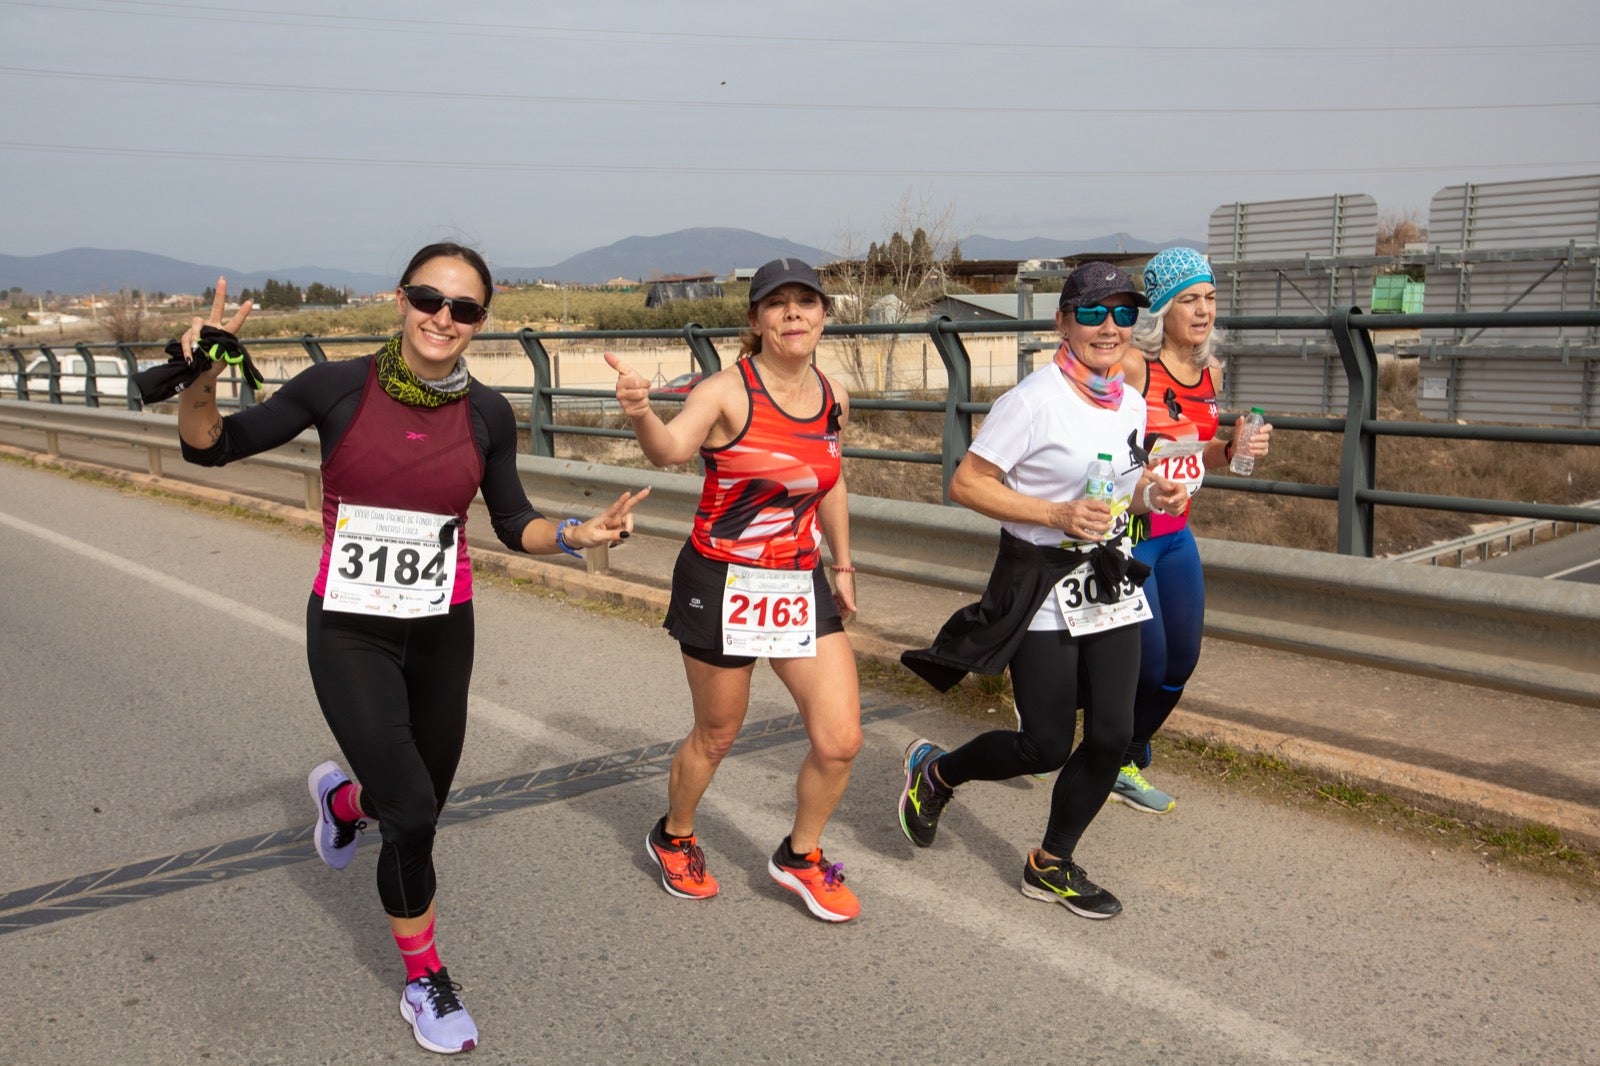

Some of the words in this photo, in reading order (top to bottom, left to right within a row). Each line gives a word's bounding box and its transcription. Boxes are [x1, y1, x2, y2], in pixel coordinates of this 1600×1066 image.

[1160, 454, 1200, 479] 128
[338, 542, 448, 587] 3184
[728, 594, 809, 628] 2163
